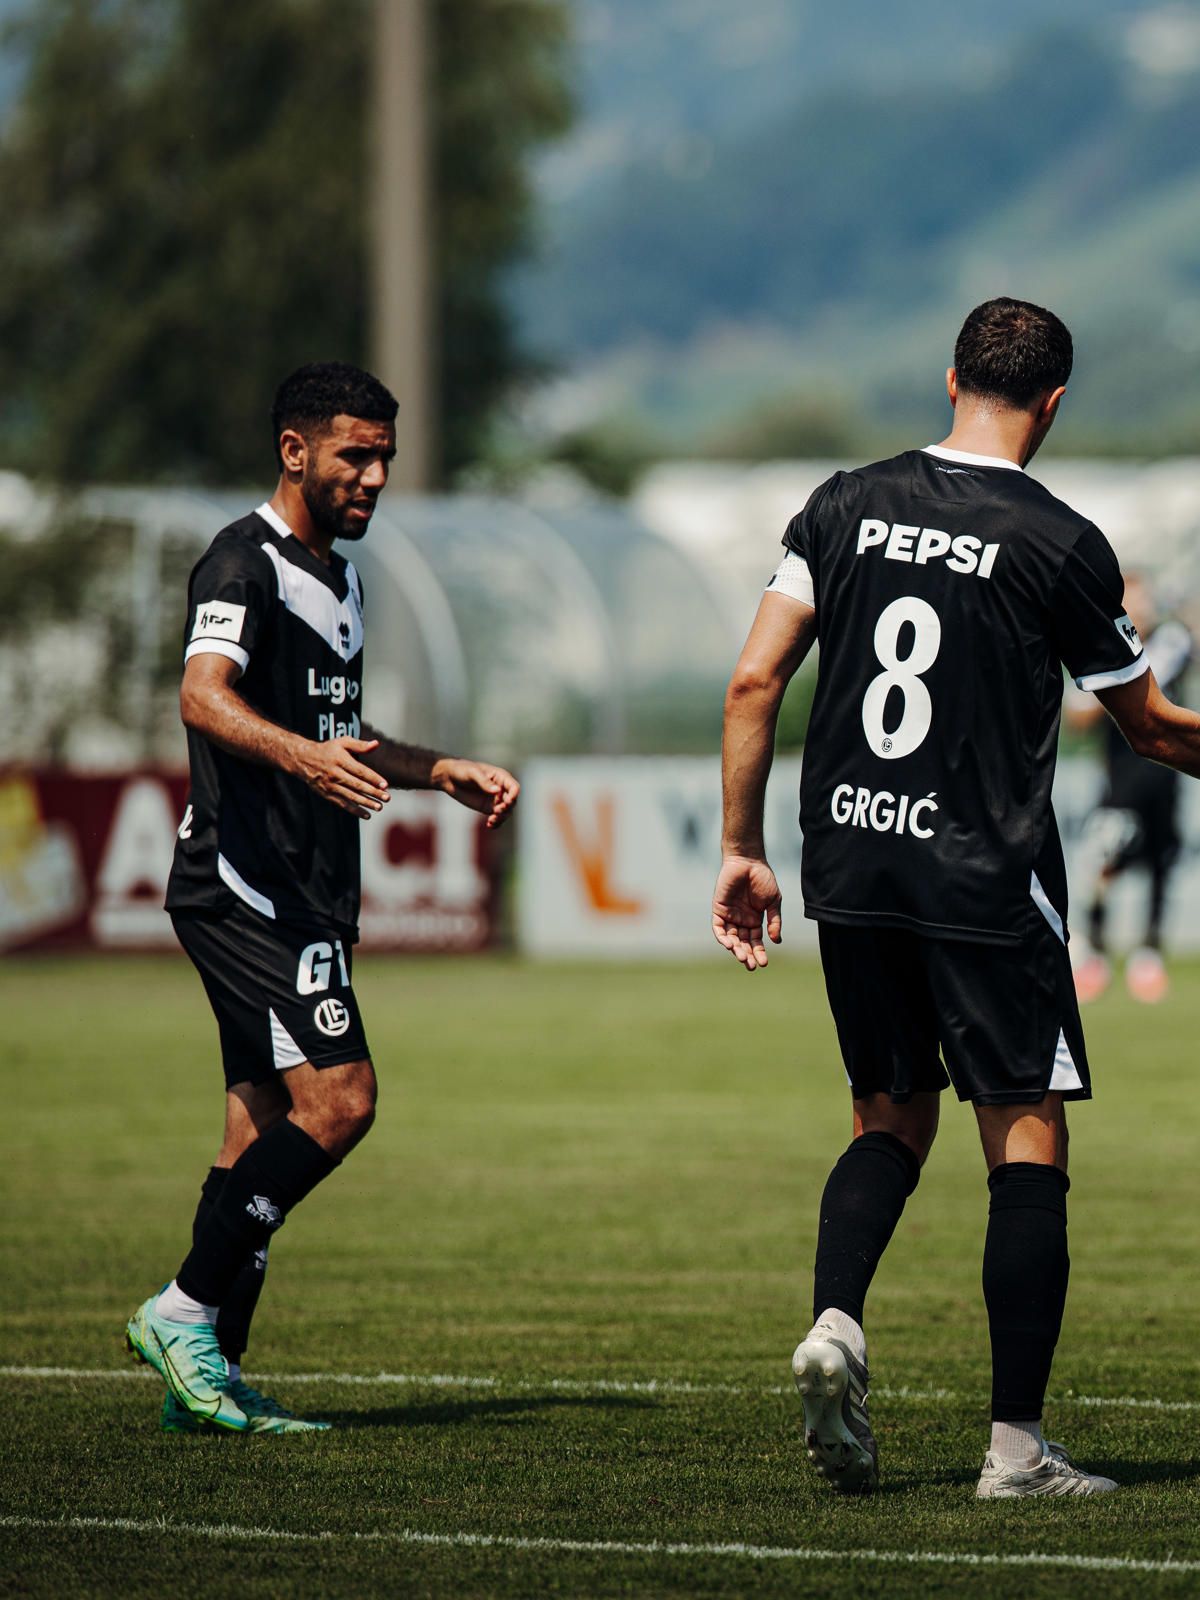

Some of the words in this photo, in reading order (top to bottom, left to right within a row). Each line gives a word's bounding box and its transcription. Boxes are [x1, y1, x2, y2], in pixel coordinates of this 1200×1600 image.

[856, 519, 1000, 579] PEPSI
[862, 596, 942, 759] 8
[831, 783, 939, 839] GRGIĆ
